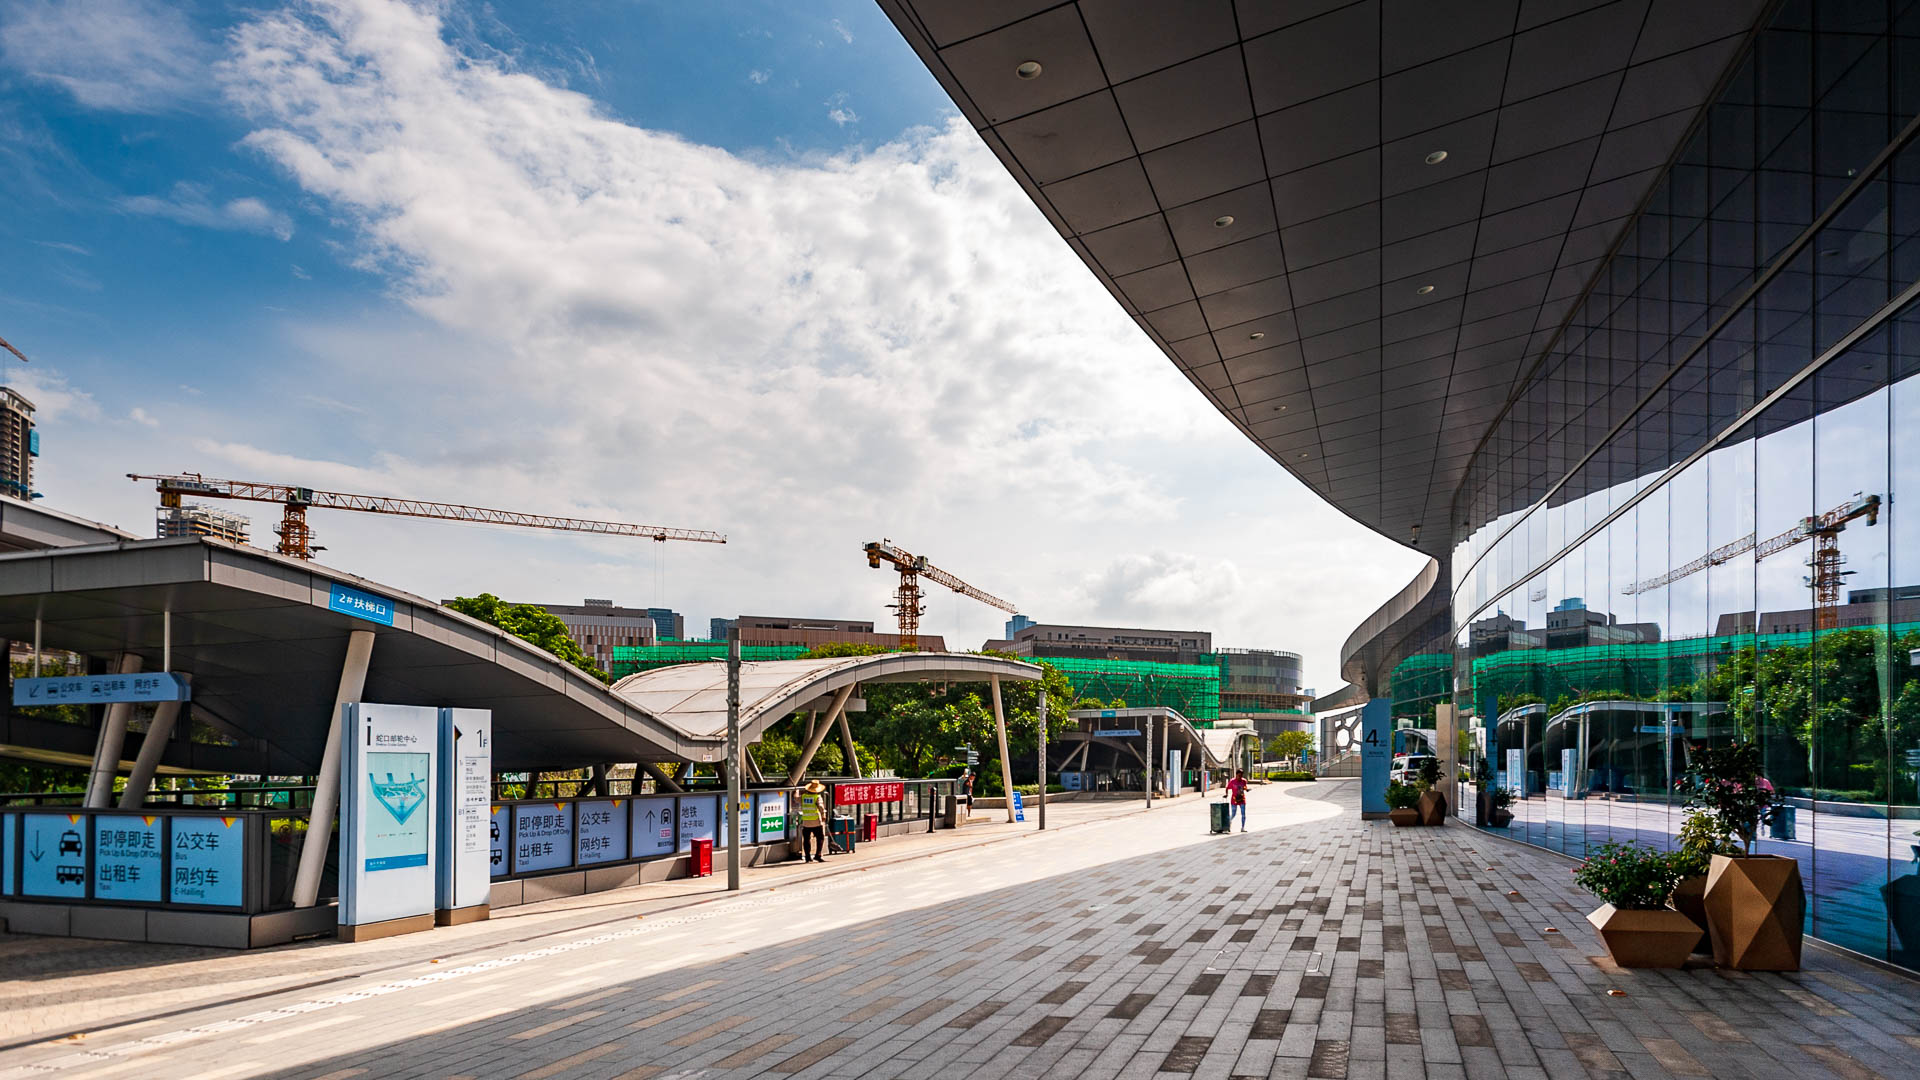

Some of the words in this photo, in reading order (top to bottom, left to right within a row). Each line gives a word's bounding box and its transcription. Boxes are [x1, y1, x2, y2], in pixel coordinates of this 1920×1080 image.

[60, 682, 83, 693] 公交车
[1365, 729, 1380, 747] 4
[580, 811, 611, 825] 公交车
[682, 806, 697, 818] 地铁
[520, 814, 565, 830] 即停即走
[100, 829, 156, 849] 即停即走
[175, 832, 219, 851] 公交车
[580, 836, 611, 851] 网约车
[99, 849, 111, 857] Pick
[112, 850, 120, 858] Up
[126, 851, 139, 859] Drop
[175, 852, 187, 860] Bus
[520, 842, 553, 858] 出租车
[100, 864, 141, 883] 出租车
[175, 867, 219, 886] 网约车
[174, 887, 205, 898] E-Hailing
